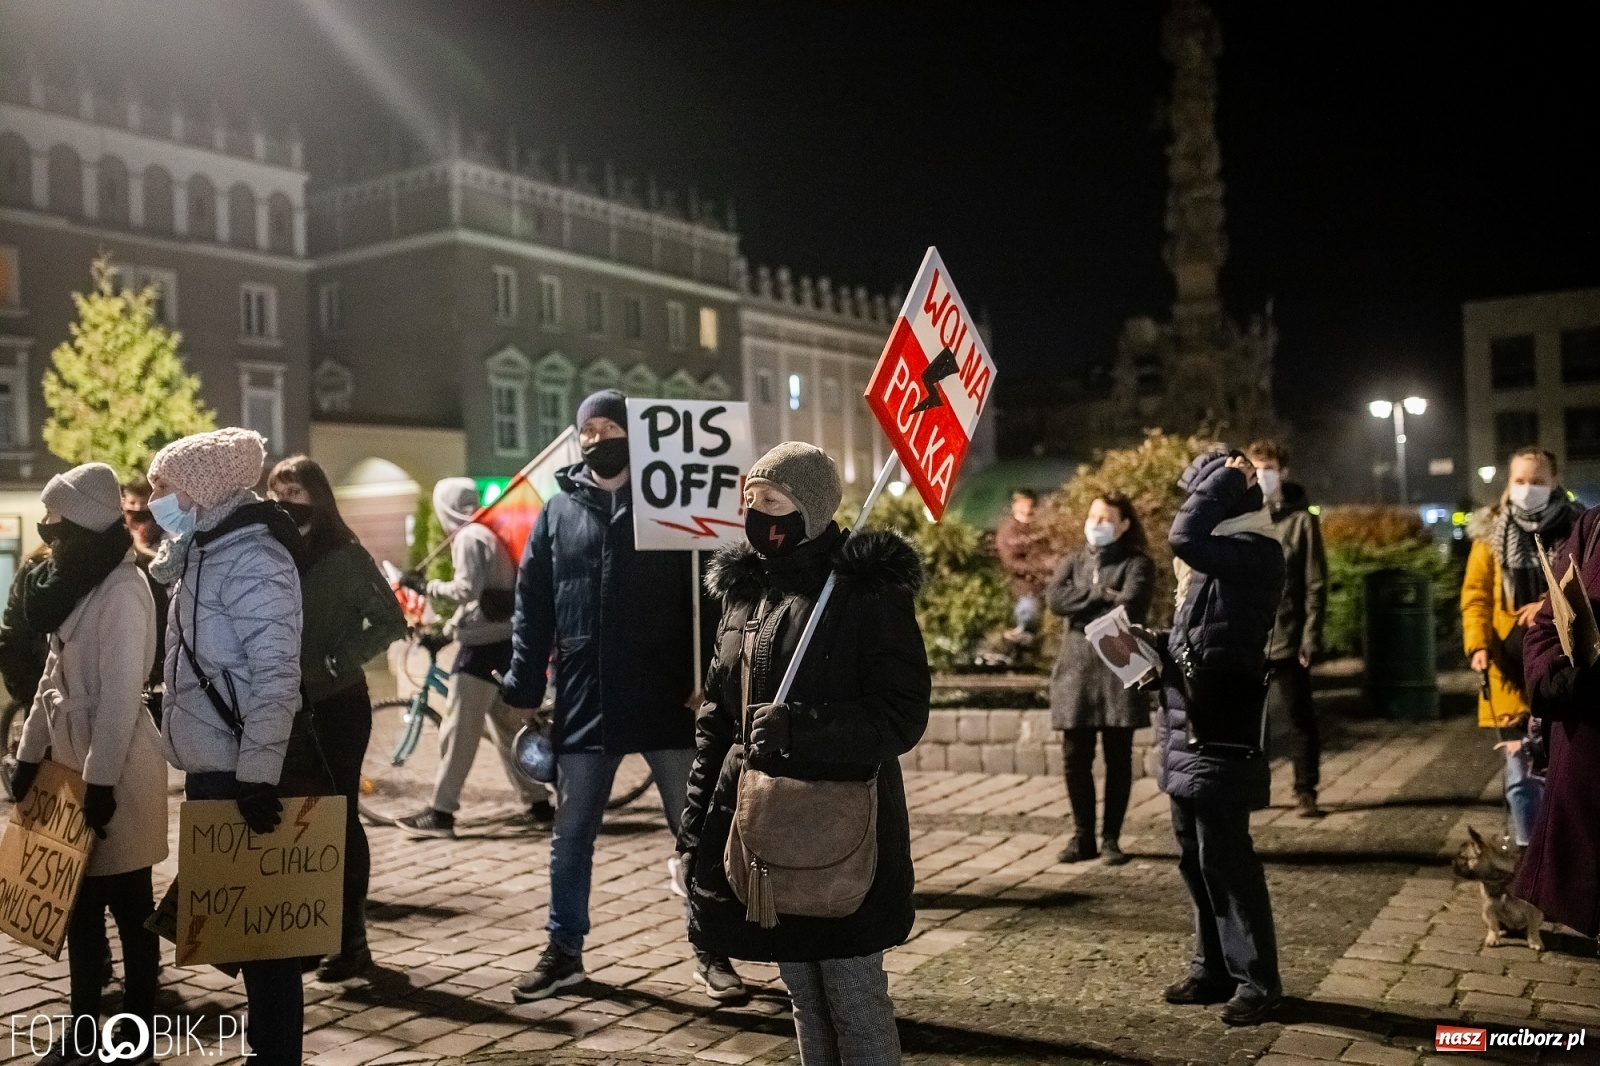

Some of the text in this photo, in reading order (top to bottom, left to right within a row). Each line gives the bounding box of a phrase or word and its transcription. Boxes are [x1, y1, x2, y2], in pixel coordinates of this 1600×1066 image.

[640, 405, 731, 457] PIS
[883, 355, 954, 506] POLKA
[260, 844, 339, 876] CIAŁO
